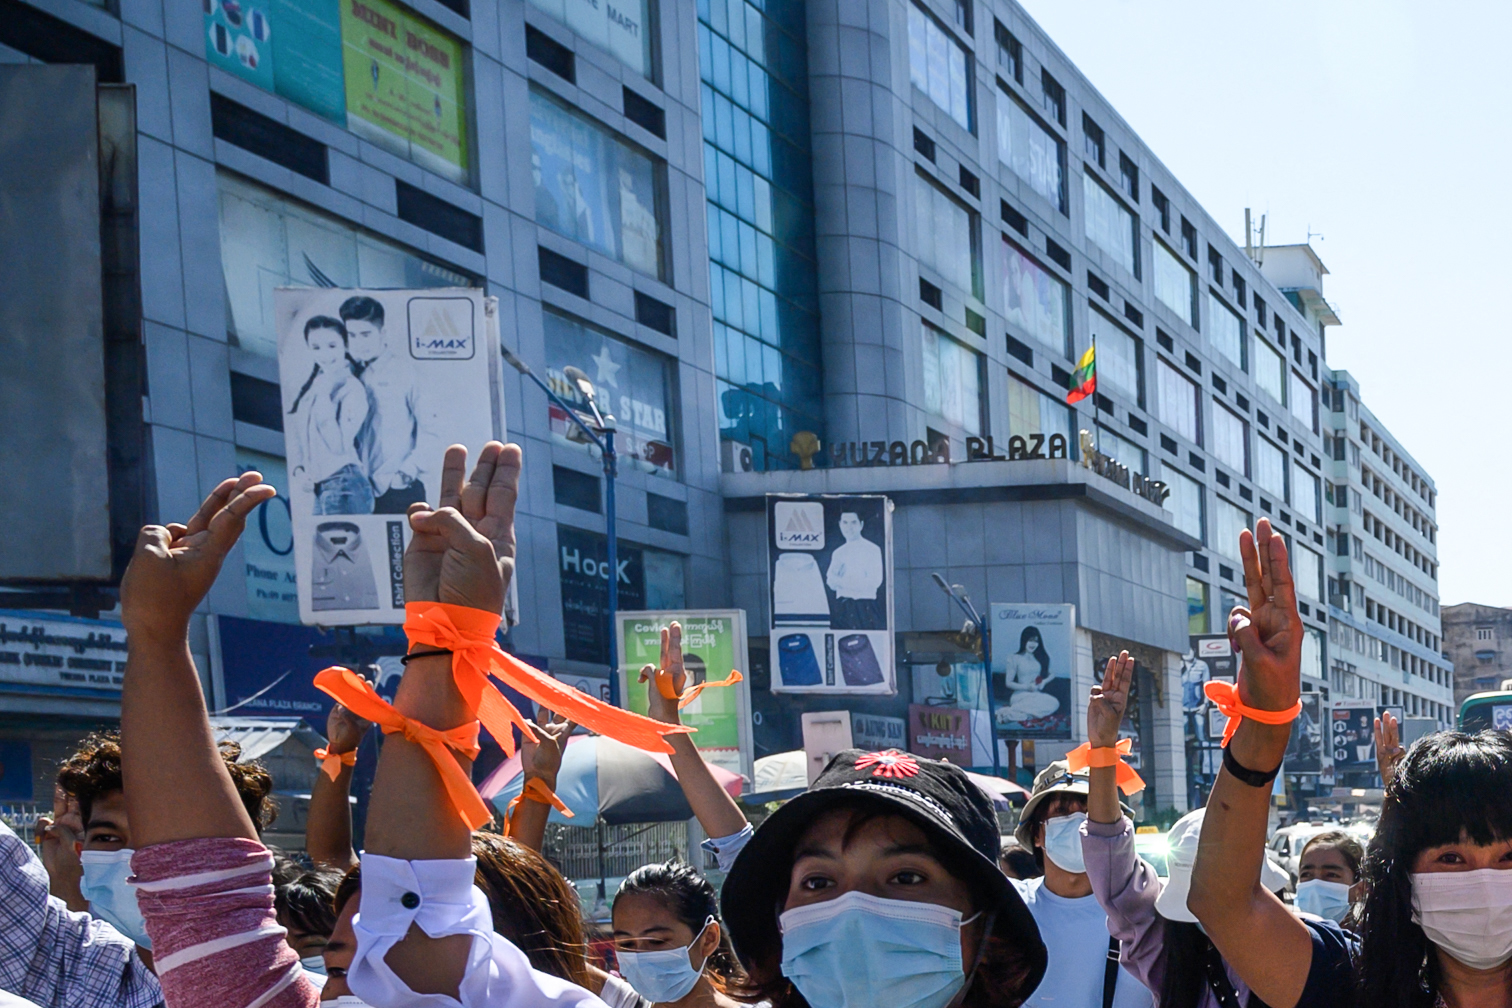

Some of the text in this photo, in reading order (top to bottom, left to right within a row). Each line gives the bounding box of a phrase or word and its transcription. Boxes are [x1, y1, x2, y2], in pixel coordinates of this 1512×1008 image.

[607, 4, 639, 38] MART
[619, 394, 667, 435] STAR
[829, 432, 1067, 467] YUZANA PLAZA
[246, 563, 278, 581] Phone
[389, 525, 405, 606] Shirt Collection
